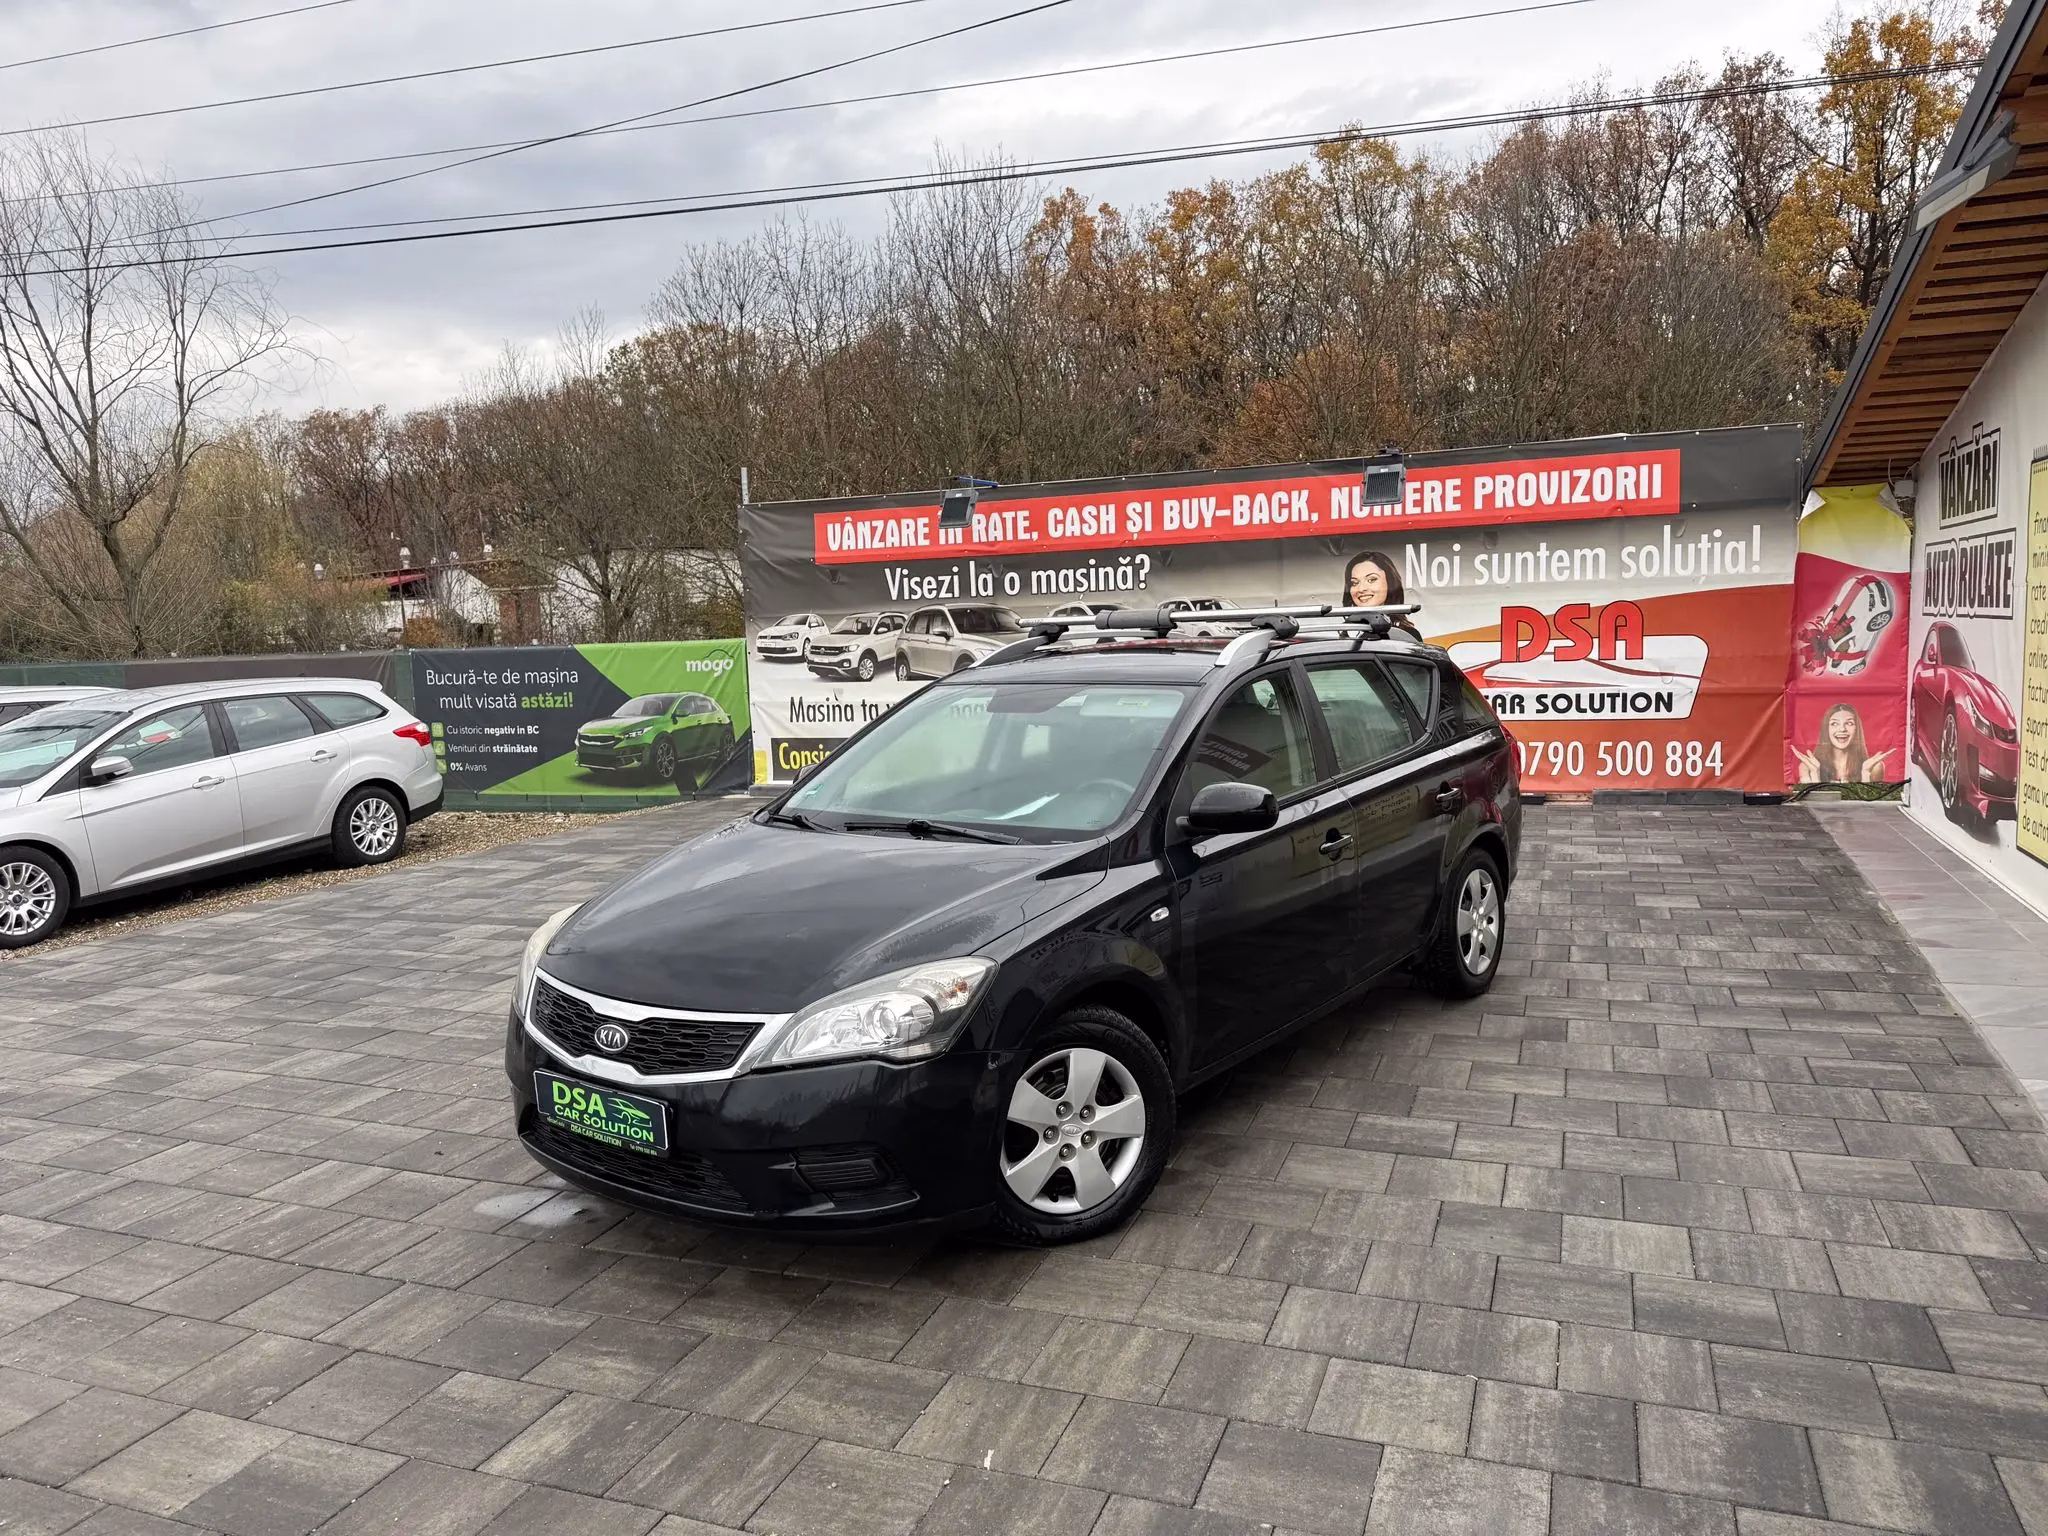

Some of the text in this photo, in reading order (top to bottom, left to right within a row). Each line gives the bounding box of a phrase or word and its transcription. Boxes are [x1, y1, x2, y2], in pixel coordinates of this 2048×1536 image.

[826, 516, 930, 552] VÂNZARE
[972, 511, 1039, 543] RATE,
[1047, 504, 1116, 538] CASH
[1126, 501, 1152, 540] ȘI
[1473, 463, 1662, 510] PROVIZORII
[1405, 524, 1762, 588] Noi suntem soluția!
[884, 553, 1151, 601] Visezi la o mașină?
[1925, 540, 2013, 609] AUTO RULATE
[1500, 600, 1643, 663] DSA
[426, 667, 579, 688] Bucură-te de mașina
[685, 657, 734, 677] mogo
[440, 692, 574, 709] mult visată astăzi!
[860, 699, 879, 722] ta
[1484, 691, 1673, 714] AR SOLUTION
[447, 725, 458, 735] Cu
[459, 725, 483, 735] istoric
[484, 725, 515, 737] negativ
[527, 725, 540, 735] BC
[448, 743, 538, 753] Venituri din străinătate
[1596, 741, 1653, 776] 500
[1665, 741, 1724, 776] 884
[450, 762, 487, 772] 0% Avans
[599, 1029, 621, 1047] KIA
[552, 1081, 607, 1118] DSA
[554, 1105, 580, 1121] CAR
[583, 1113, 654, 1142] SOLUTION
